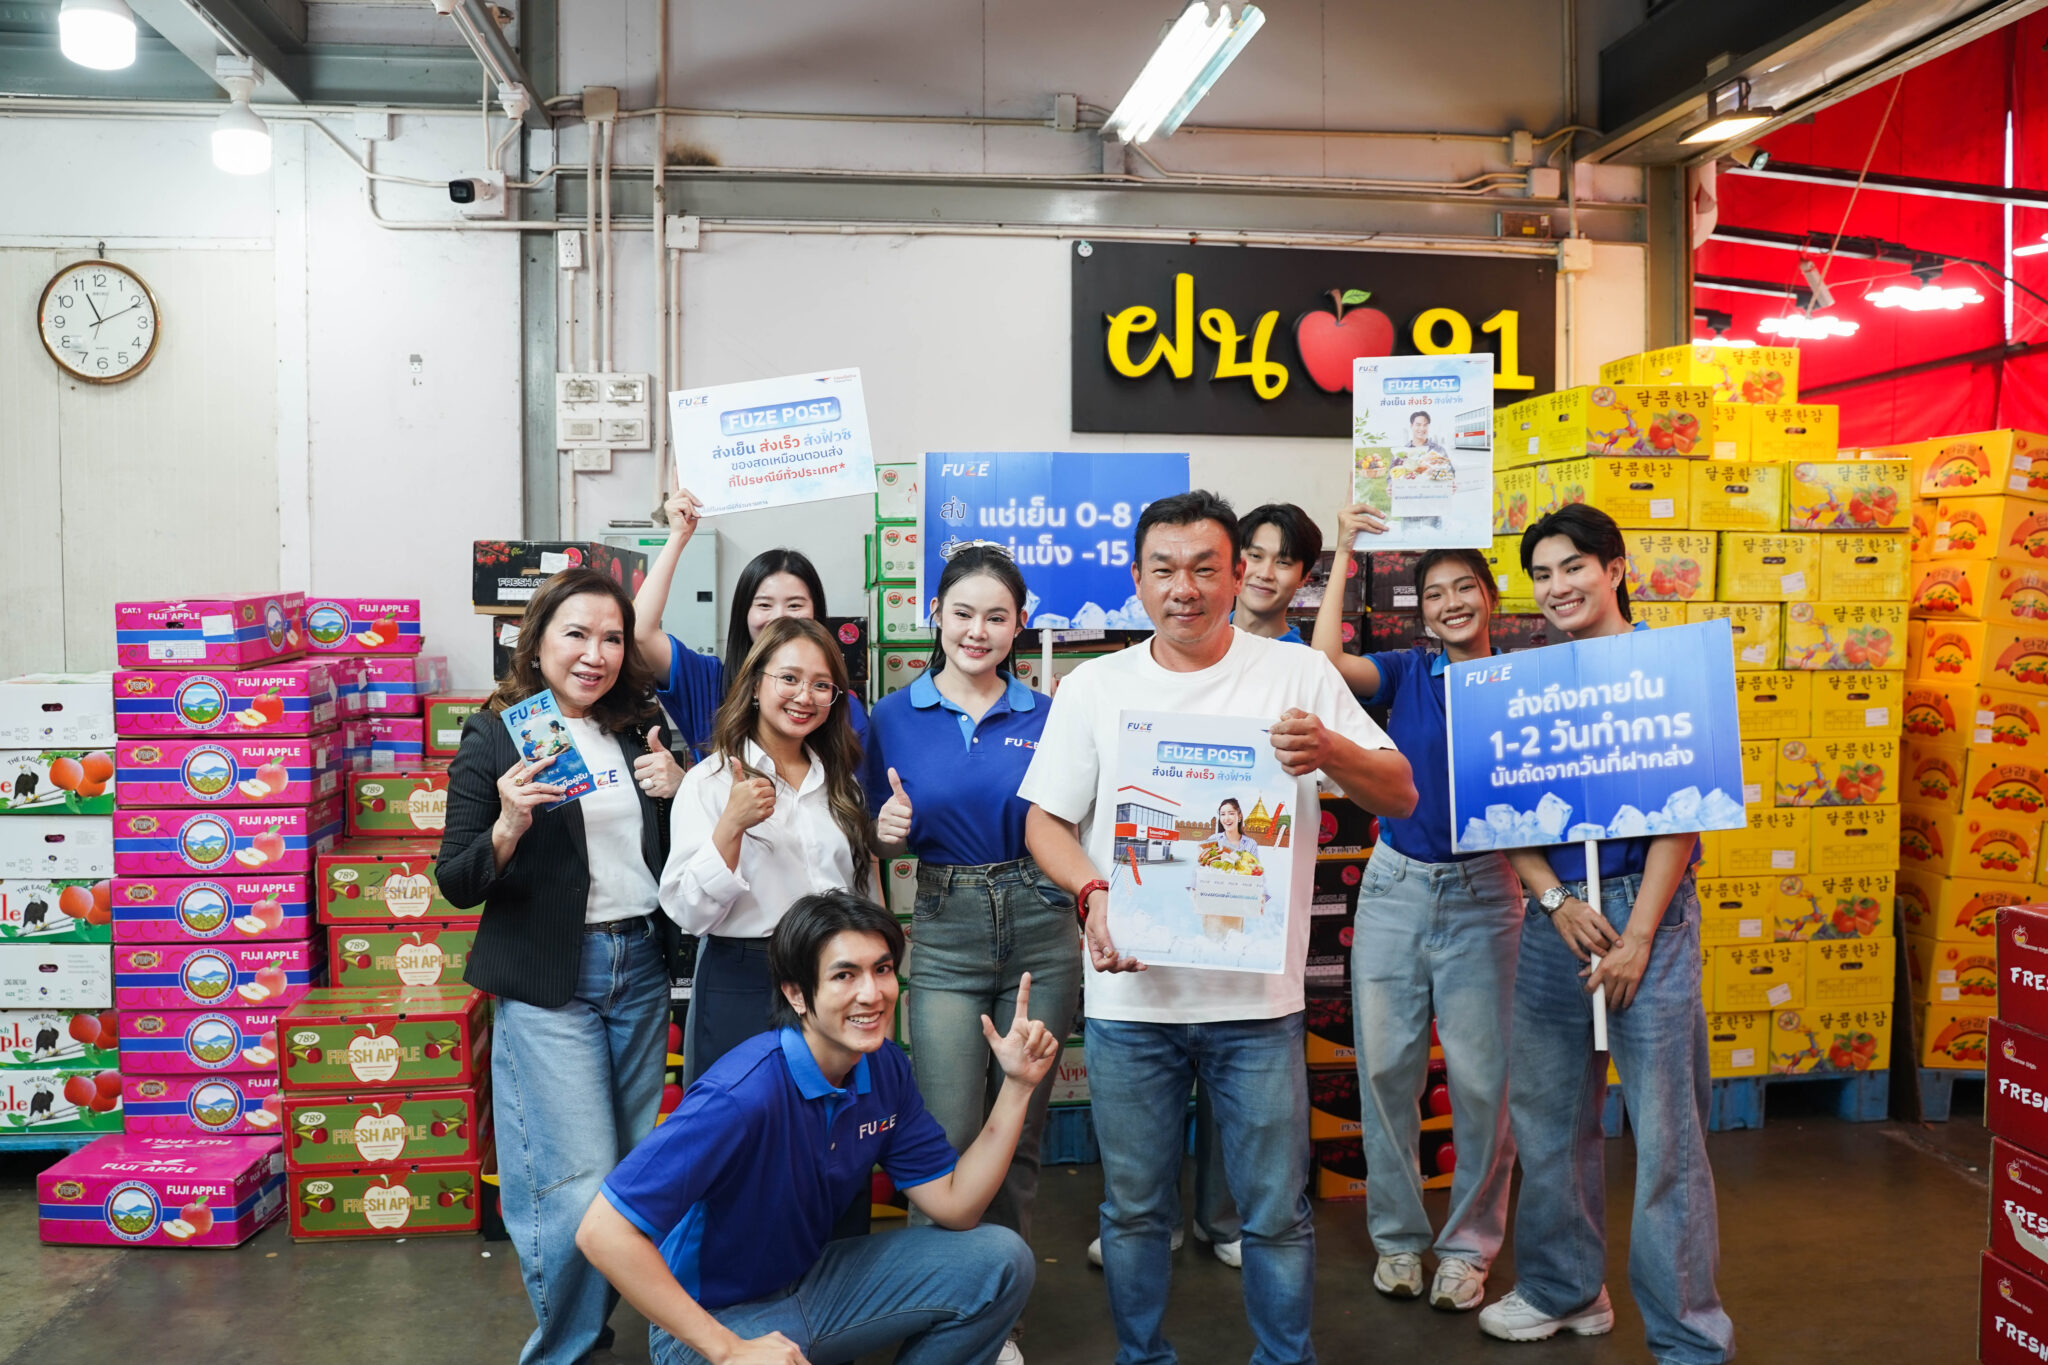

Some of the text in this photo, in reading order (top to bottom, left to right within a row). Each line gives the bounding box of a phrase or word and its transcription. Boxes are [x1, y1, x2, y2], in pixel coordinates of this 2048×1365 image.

[74, 279, 84, 291] 11
[93, 274, 107, 287] 12
[118, 279, 123, 291] 1
[58, 295, 74, 309] 10
[130, 295, 141, 308] 2
[54, 315, 65, 328] 9
[137, 316, 148, 329] 3
[131, 337, 141, 348] 4
[78, 352, 88, 364] 7
[97, 357, 108, 370] 6
[118, 352, 129, 364] 5
[1359, 365, 1378, 373] FUZE
[1388, 378, 1456, 392] FUZE POST
[678, 395, 709, 408] FUZE
[1637, 389, 1710, 409] 달콤한감
[729, 401, 832, 431] FUZE POST
[1765, 408, 1824, 423] 달콤한감
[712, 440, 756, 460] ส่งเย็น
[759, 434, 801, 453] ส่งเร็ว
[731, 447, 843, 471] ของสดเหมือนตอนส่ง
[941, 462, 990, 477] FUZE
[1609, 461, 1674, 478] 달콤한감
[940, 496, 966, 520] ส่ง
[979, 496, 1066, 528] แช่เย็น
[1640, 536, 1714, 554] 달콤한감
[1743, 538, 1807, 554] 달콤한감
[498, 578, 532, 587] FRESH
[359, 604, 410, 613] FUJI APPLE
[1832, 606, 1903, 624] 달콤한감
[169, 612, 201, 620] APPLE
[1465, 664, 1512, 687] FUZE
[237, 678, 296, 687] FUJI APPLE
[1828, 674, 1890, 691] 달콤한감
[1507, 670, 1665, 719] ส่งถึงภายใน
[448, 706, 470, 715] FRESH
[508, 696, 551, 726] FUZE
[1127, 722, 1153, 731] FUZE
[1490, 711, 1693, 760] 1-2 วันทำการ
[242, 747, 301, 757] FUJI APPLE
[1163, 743, 1249, 763] FUZE POST
[1825, 742, 1895, 760] 달콤한감
[7, 755, 43, 766] THE EAGLE
[1491, 744, 1694, 787] นับถัดจากวันที่ฝากส่ง
[1152, 764, 1184, 779] ส่งเย็น
[1185, 768, 1216, 781] ส่งเร็ว
[365, 785, 381, 794] 789
[389, 800, 429, 814] FRESH
[239, 816, 297, 825] FUJI APPLE
[1827, 810, 1887, 826] 달콤한감
[338, 871, 355, 880] 789
[17, 884, 52, 894] THE EAGLE
[237, 883, 295, 893] FUJI APPLE
[1700, 883, 1762, 899] 달콤한감
[1822, 876, 1891, 894] 달콤한감
[364, 887, 406, 901] FRESH
[349, 941, 366, 949] 789
[1820, 942, 1881, 960] 달콤한감
[241, 951, 300, 960] FUJI APPLE
[375, 954, 463, 970] FRESH APPLE
[1731, 948, 1793, 965] 달콤한감
[28, 1013, 62, 1024] THE EAGLE
[246, 1015, 269, 1025] FUJI
[1819, 1011, 1888, 1030] 달콤한감
[298, 1034, 316, 1042] 789
[326, 1047, 421, 1065] FRESH APPLE
[23, 1075, 58, 1086] THE EAGLE
[248, 1079, 271, 1088] FUJI
[304, 1114, 322, 1123] 789
[859, 1114, 897, 1140] FUZE
[333, 1125, 427, 1145] FRESH APPLE
[101, 1162, 198, 1174] FUJI APPLE
[167, 1185, 227, 1196] FUJI APPLE
[311, 1183, 329, 1192] 789
[343, 1195, 430, 1214] FRESH APPLE
